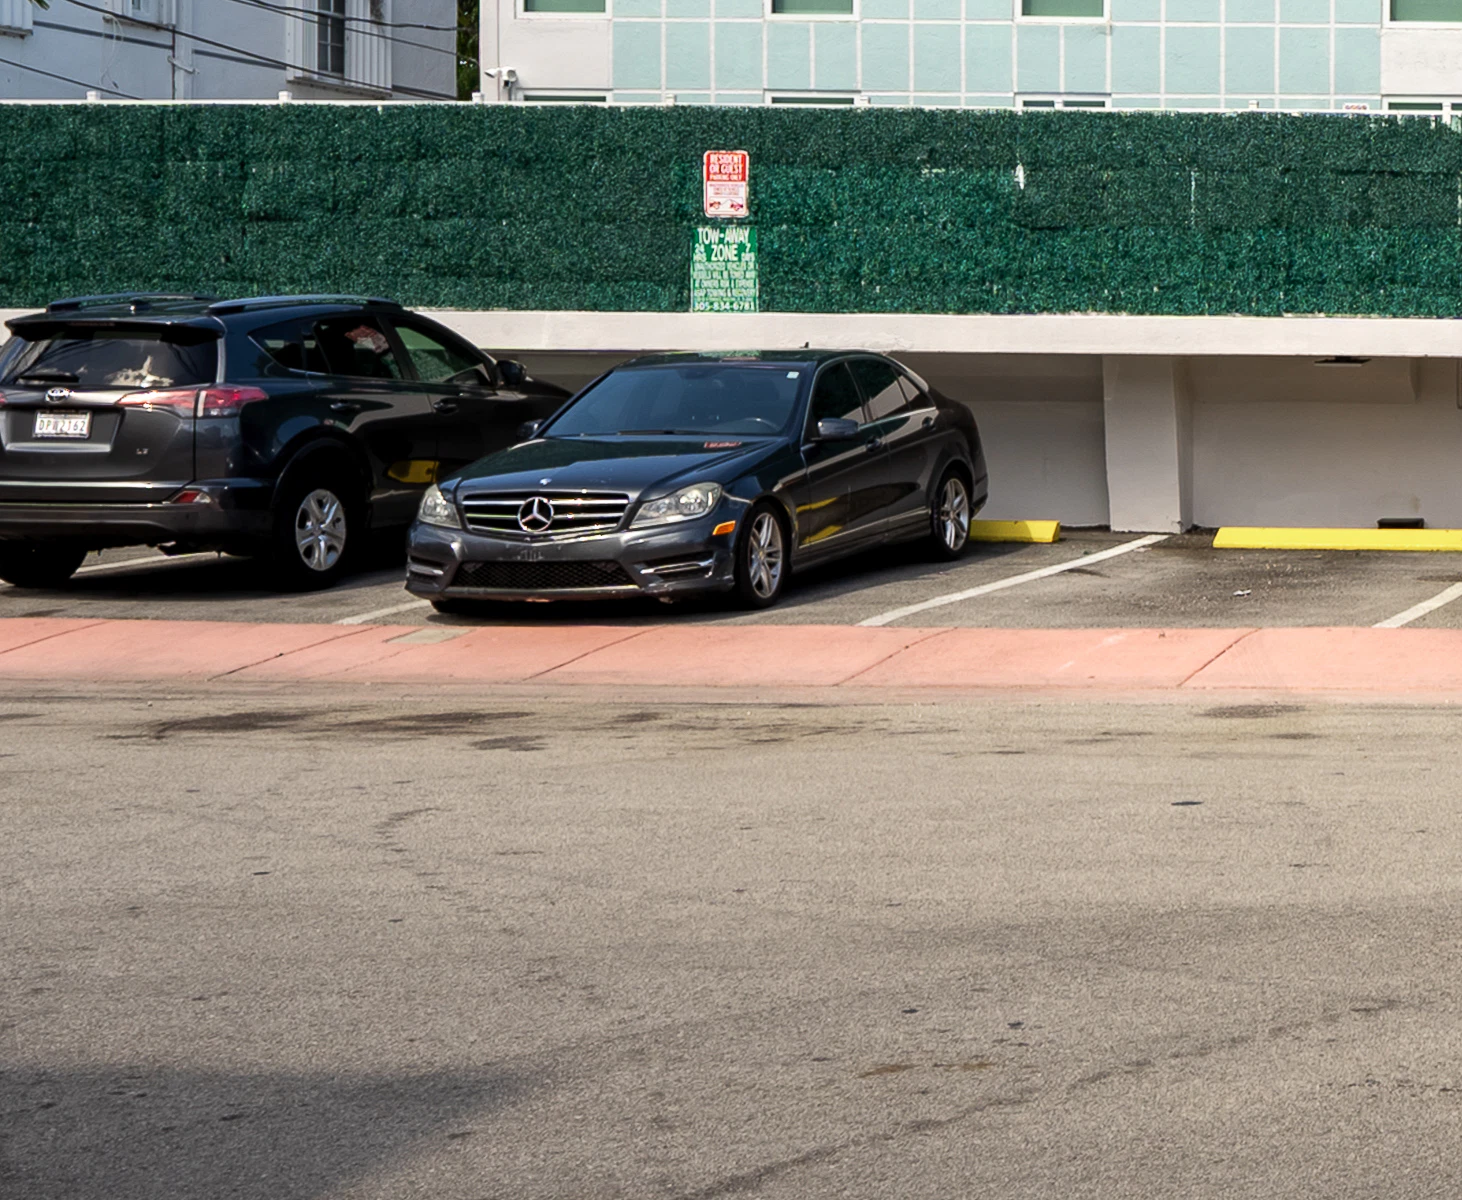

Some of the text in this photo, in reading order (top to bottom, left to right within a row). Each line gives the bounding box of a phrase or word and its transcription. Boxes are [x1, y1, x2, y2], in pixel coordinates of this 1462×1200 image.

[709, 154, 742, 163] RESIDENT
[709, 163, 742, 173] OR GUEST
[697, 226, 750, 244] TOW-AWAY
[711, 244, 738, 261] ZONE
[38, 420, 86, 432] DP2162
